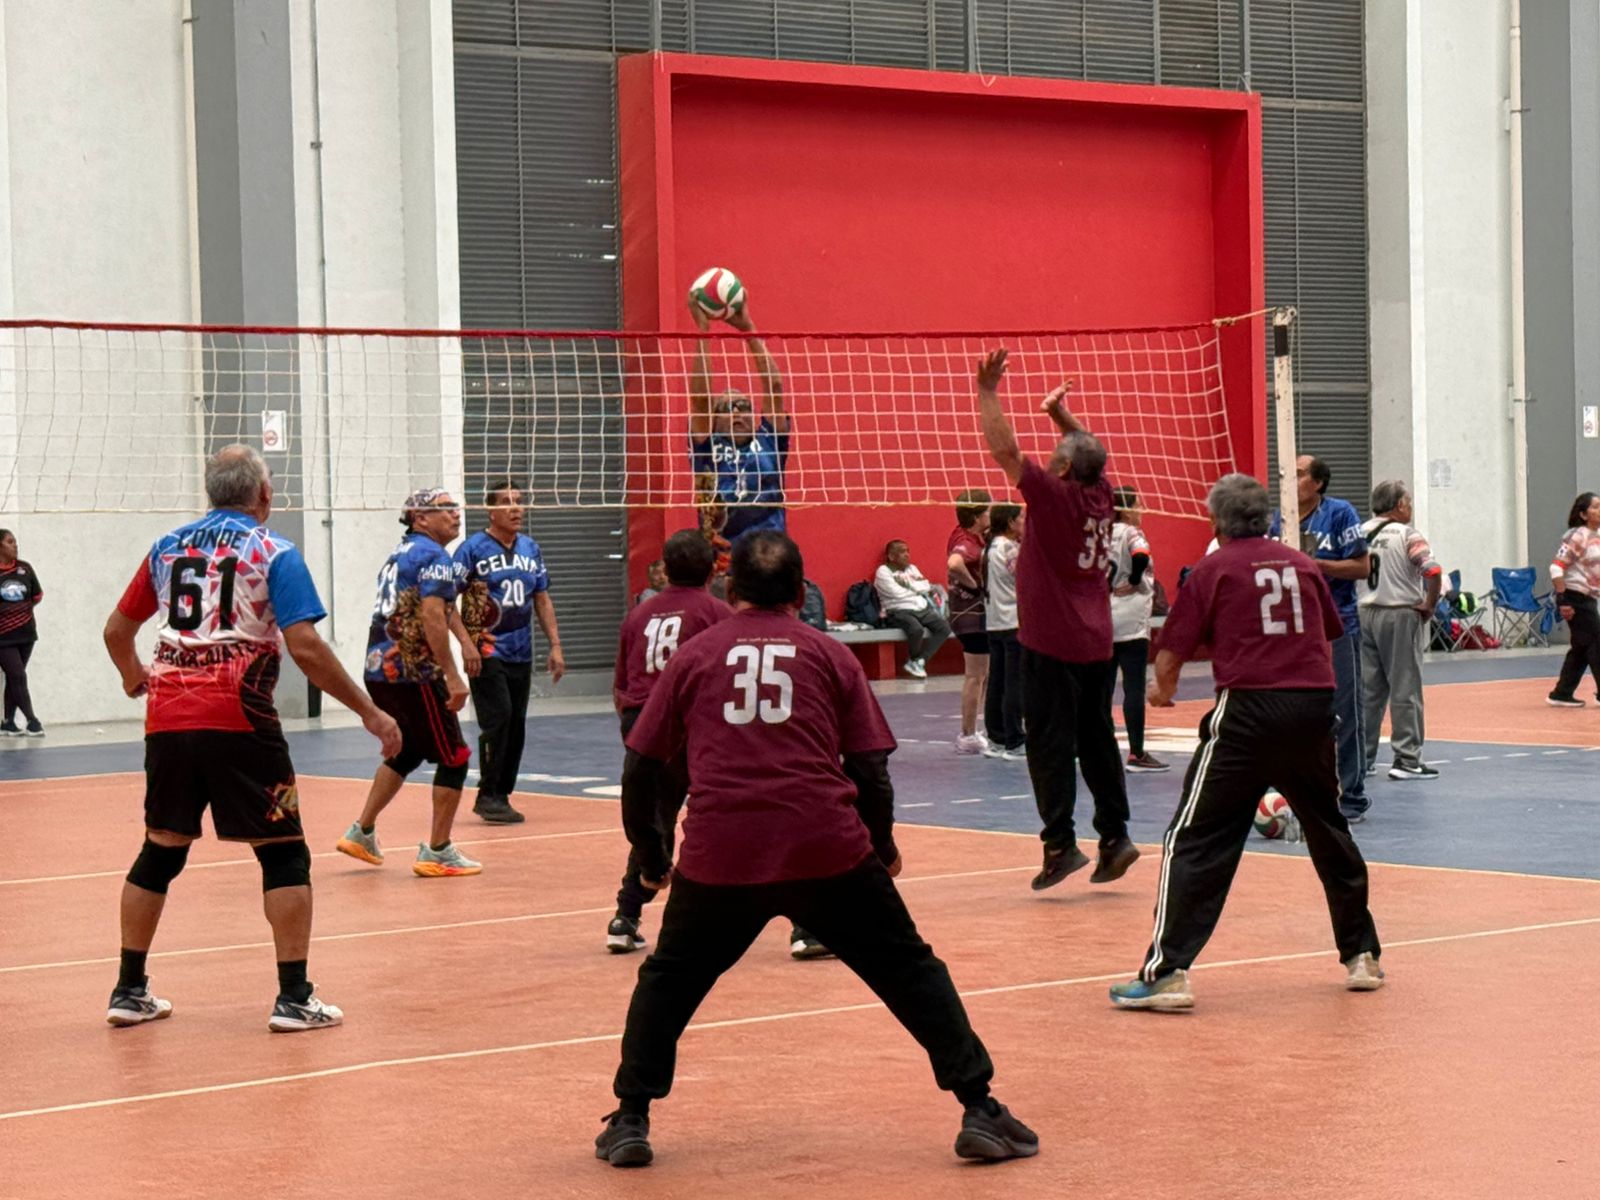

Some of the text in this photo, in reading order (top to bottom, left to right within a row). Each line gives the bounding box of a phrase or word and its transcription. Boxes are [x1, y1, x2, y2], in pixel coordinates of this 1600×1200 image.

[177, 528, 250, 550] CONDE
[476, 553, 537, 576] CELAYA
[168, 556, 240, 631] 61
[500, 578, 525, 608] 20
[1254, 566, 1305, 635] 21
[643, 615, 682, 675] 18
[723, 644, 797, 725] 35
